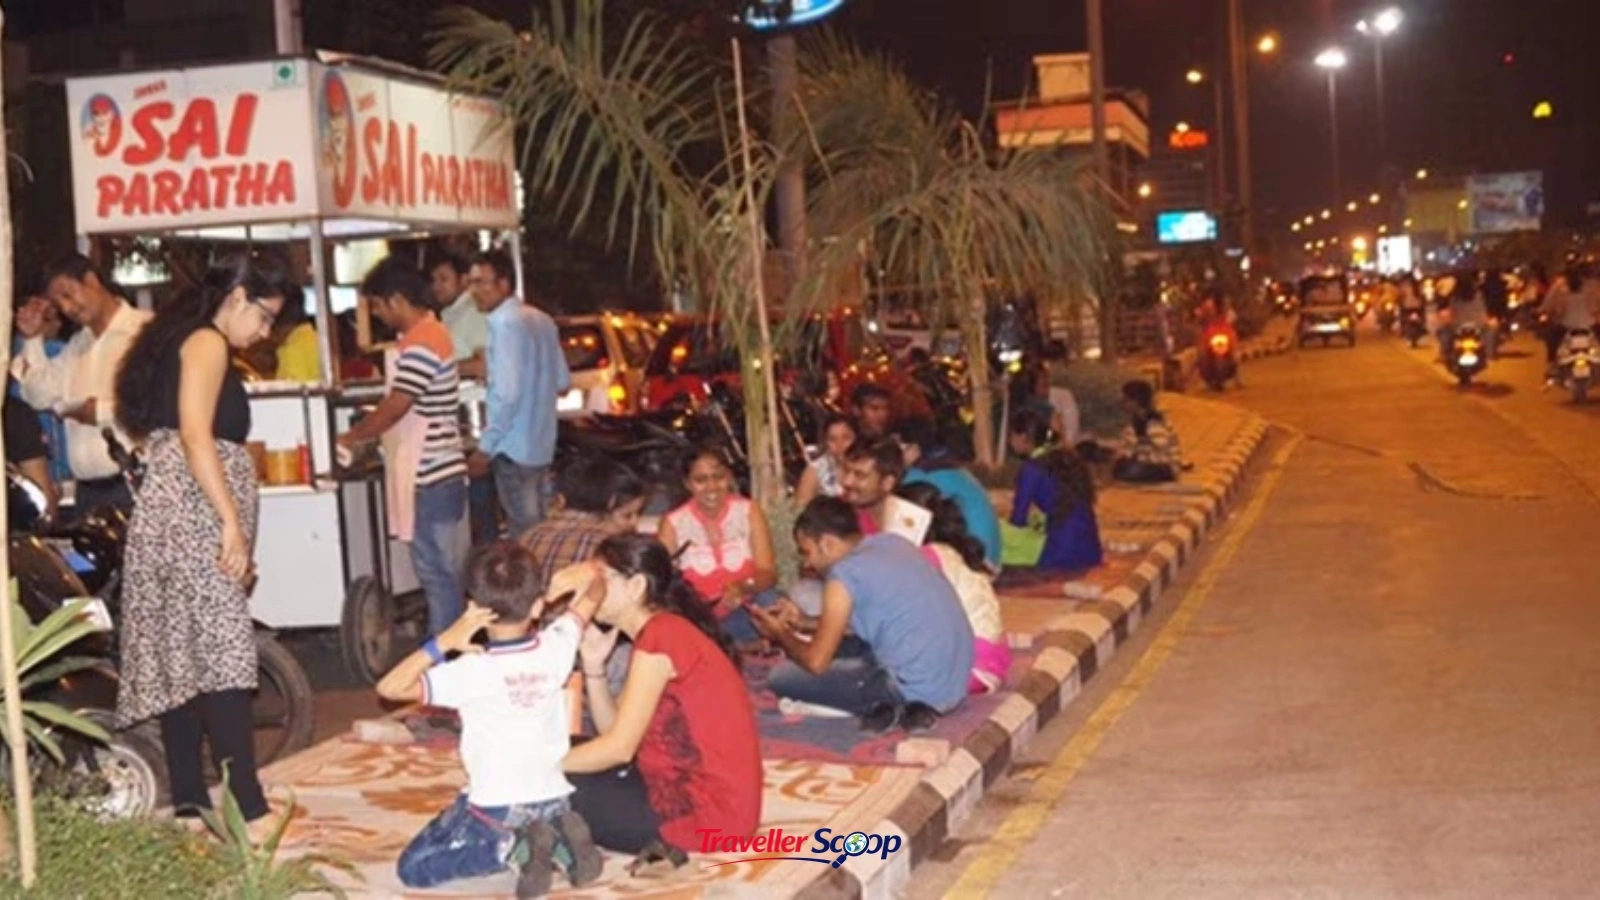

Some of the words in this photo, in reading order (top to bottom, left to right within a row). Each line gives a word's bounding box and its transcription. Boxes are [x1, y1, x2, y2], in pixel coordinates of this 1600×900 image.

[122, 92, 258, 166] SAI
[362, 116, 416, 208] SAI
[420, 151, 510, 210] PARATHA
[96, 159, 296, 218] PARATHA
